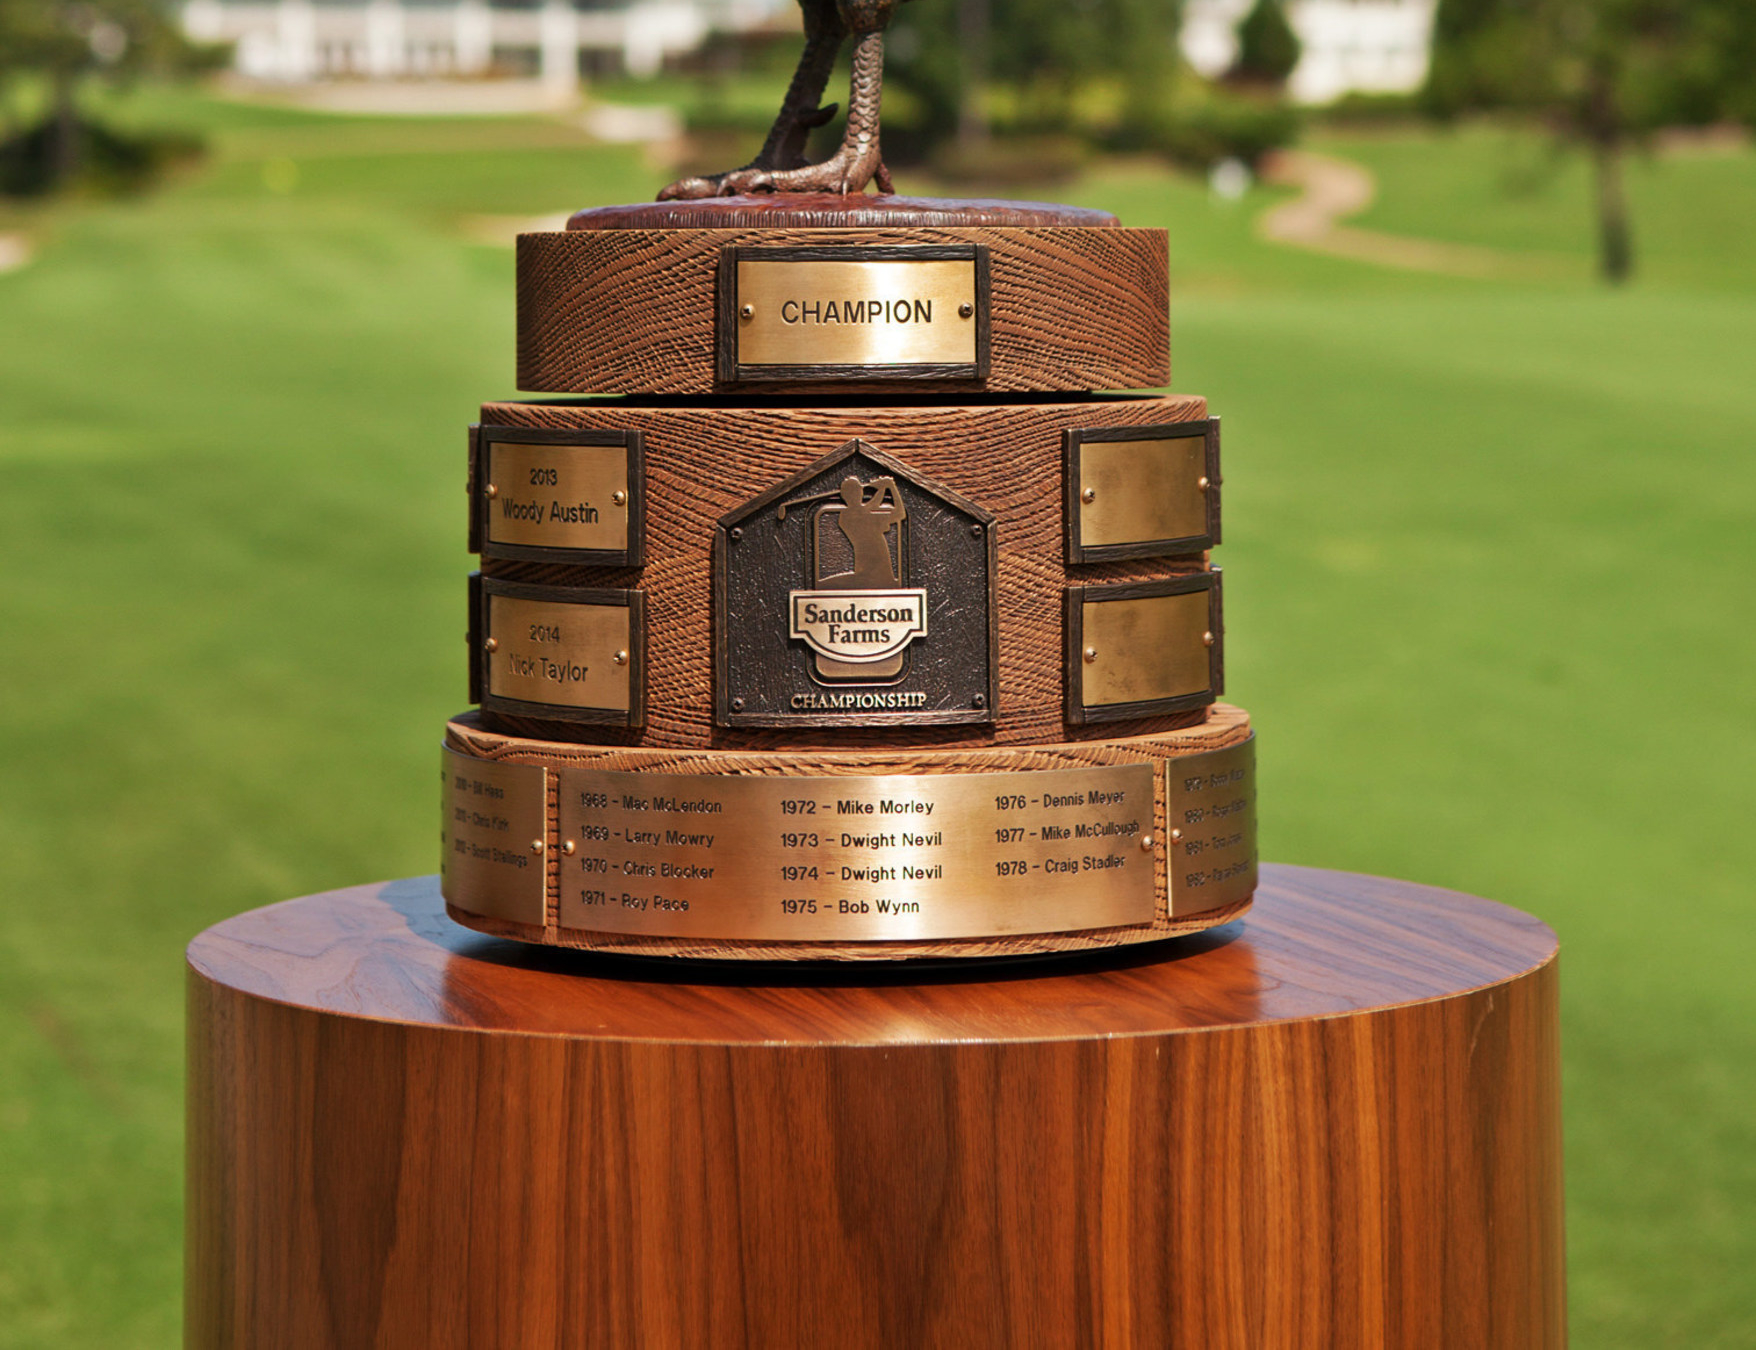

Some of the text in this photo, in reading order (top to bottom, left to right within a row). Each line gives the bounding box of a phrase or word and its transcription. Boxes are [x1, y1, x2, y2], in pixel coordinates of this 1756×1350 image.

[781, 300, 932, 324] CHAMPION
[530, 468, 558, 486] 2013
[502, 497, 598, 524] Woody Austin
[804, 603, 914, 624] Sanderson
[530, 625, 560, 643] 2014
[828, 624, 890, 644] Farms
[510, 653, 588, 683] Nick Taylor
[790, 692, 928, 709] CHAMPIONSHIP
[581, 792, 608, 808] 1968
[622, 795, 648, 810] Mac
[653, 797, 722, 813] McLendon
[780, 800, 816, 814] 1972
[837, 800, 874, 814] Mike
[880, 800, 934, 815] Morley
[995, 795, 1026, 810] 1976
[1044, 792, 1084, 808] Dennis
[1088, 790, 1125, 806] Meyer
[581, 825, 609, 840] 1969
[625, 828, 661, 846] Larry
[666, 830, 714, 848] Mowry
[780, 833, 819, 848] 1973
[841, 832, 896, 850] Dwight
[902, 832, 942, 847] Nevil
[995, 828, 1025, 843] 1977
[1042, 826, 1071, 840] Mike
[1075, 819, 1140, 838] McCullough
[581, 858, 607, 874] 1970
[624, 860, 656, 877] Chris
[661, 862, 714, 879] Blocker
[780, 866, 819, 880] 1974
[841, 866, 896, 883] Dwight
[902, 864, 943, 880] Nevil
[995, 860, 1027, 876] 1978
[1044, 858, 1078, 874] Craig
[1082, 854, 1125, 871] Stadler
[581, 890, 605, 905] 1971
[622, 893, 648, 911] Roy
[654, 895, 690, 911] Pace
[780, 900, 818, 914] 1975
[839, 900, 870, 914] Bob
[876, 899, 920, 915] Wynn
